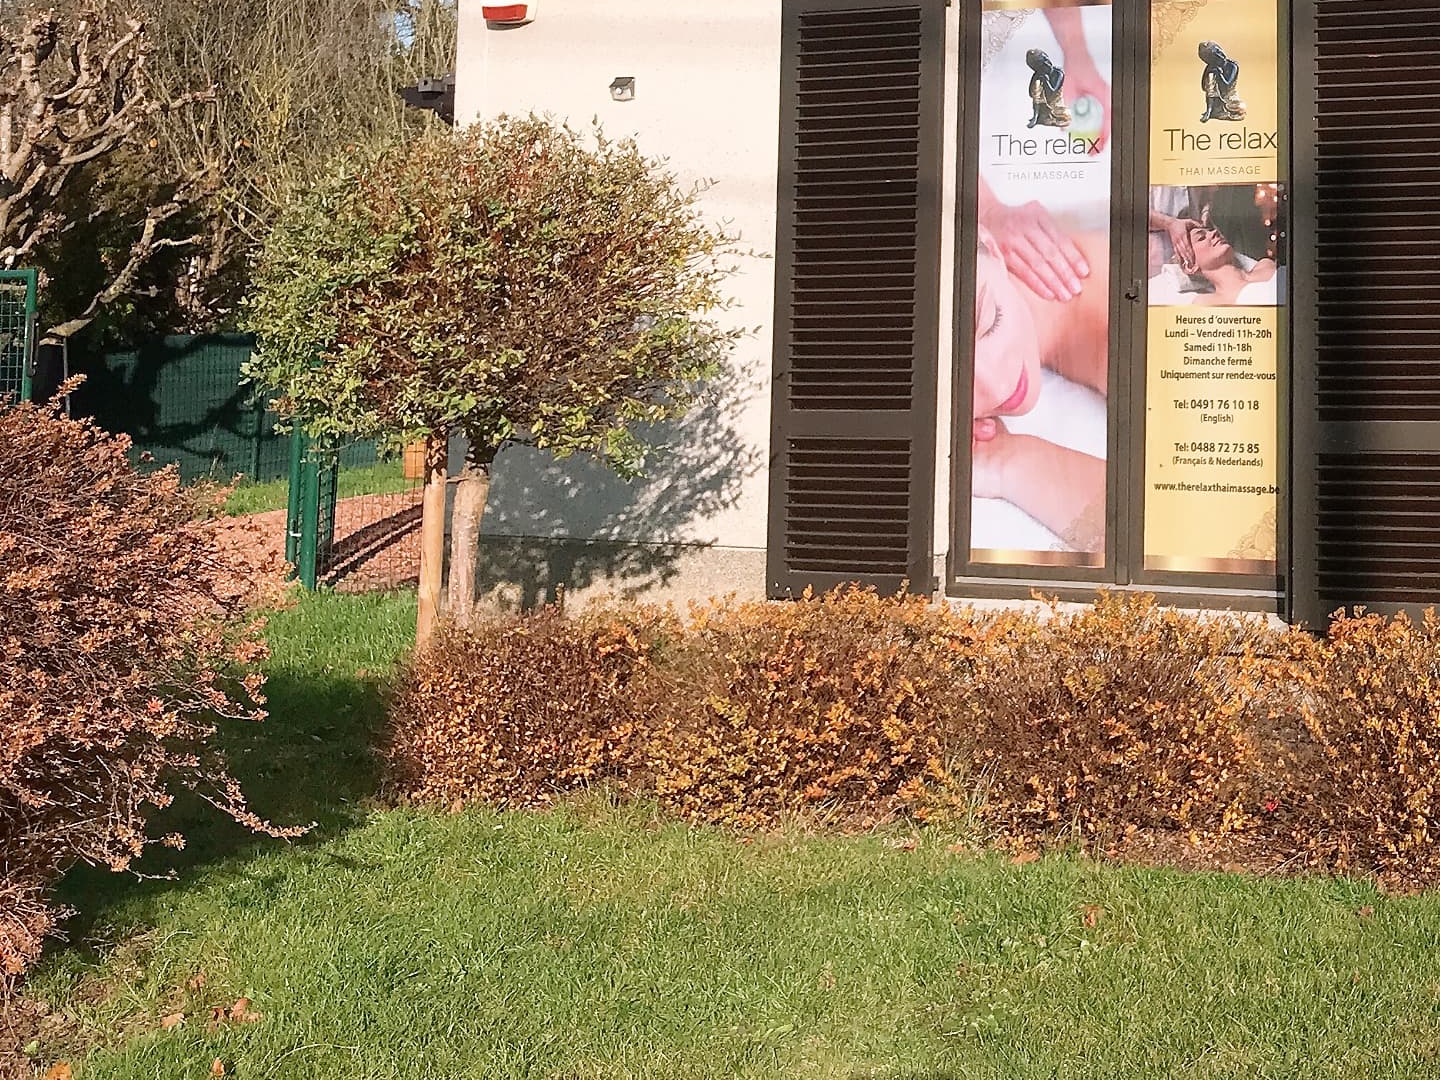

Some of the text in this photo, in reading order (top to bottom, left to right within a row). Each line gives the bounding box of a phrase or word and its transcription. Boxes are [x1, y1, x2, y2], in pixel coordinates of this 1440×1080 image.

[992, 132, 1100, 156] The relax
[1163, 127, 1277, 151] The relax
[1008, 171, 1085, 181] THAI MASSAGE
[1180, 166, 1261, 176] THAI MASSAGE
[1176, 315, 1206, 324] Heures
[1165, 329, 1189, 338] Lundi
[1197, 329, 1234, 338] Vendredi
[1237, 329, 1272, 338] 11h-20h
[1184, 343, 1252, 352] Samedi 11h-18h
[1184, 357, 1252, 366] Dimanche fermé
[1161, 370, 1210, 381] Uniquement
[1226, 371, 1276, 380] rendez-vous
[1174, 400, 1260, 410] Tel: 0491 76 10 18
[1201, 414, 1234, 424] (English)
[1174, 443, 1260, 454] Tel: 0488 72 75 85
[1172, 456, 1207, 467] (Français
[1216, 457, 1263, 467] Nederlands)
[1154, 482, 1280, 495] www.therelaxthaimassage.be
